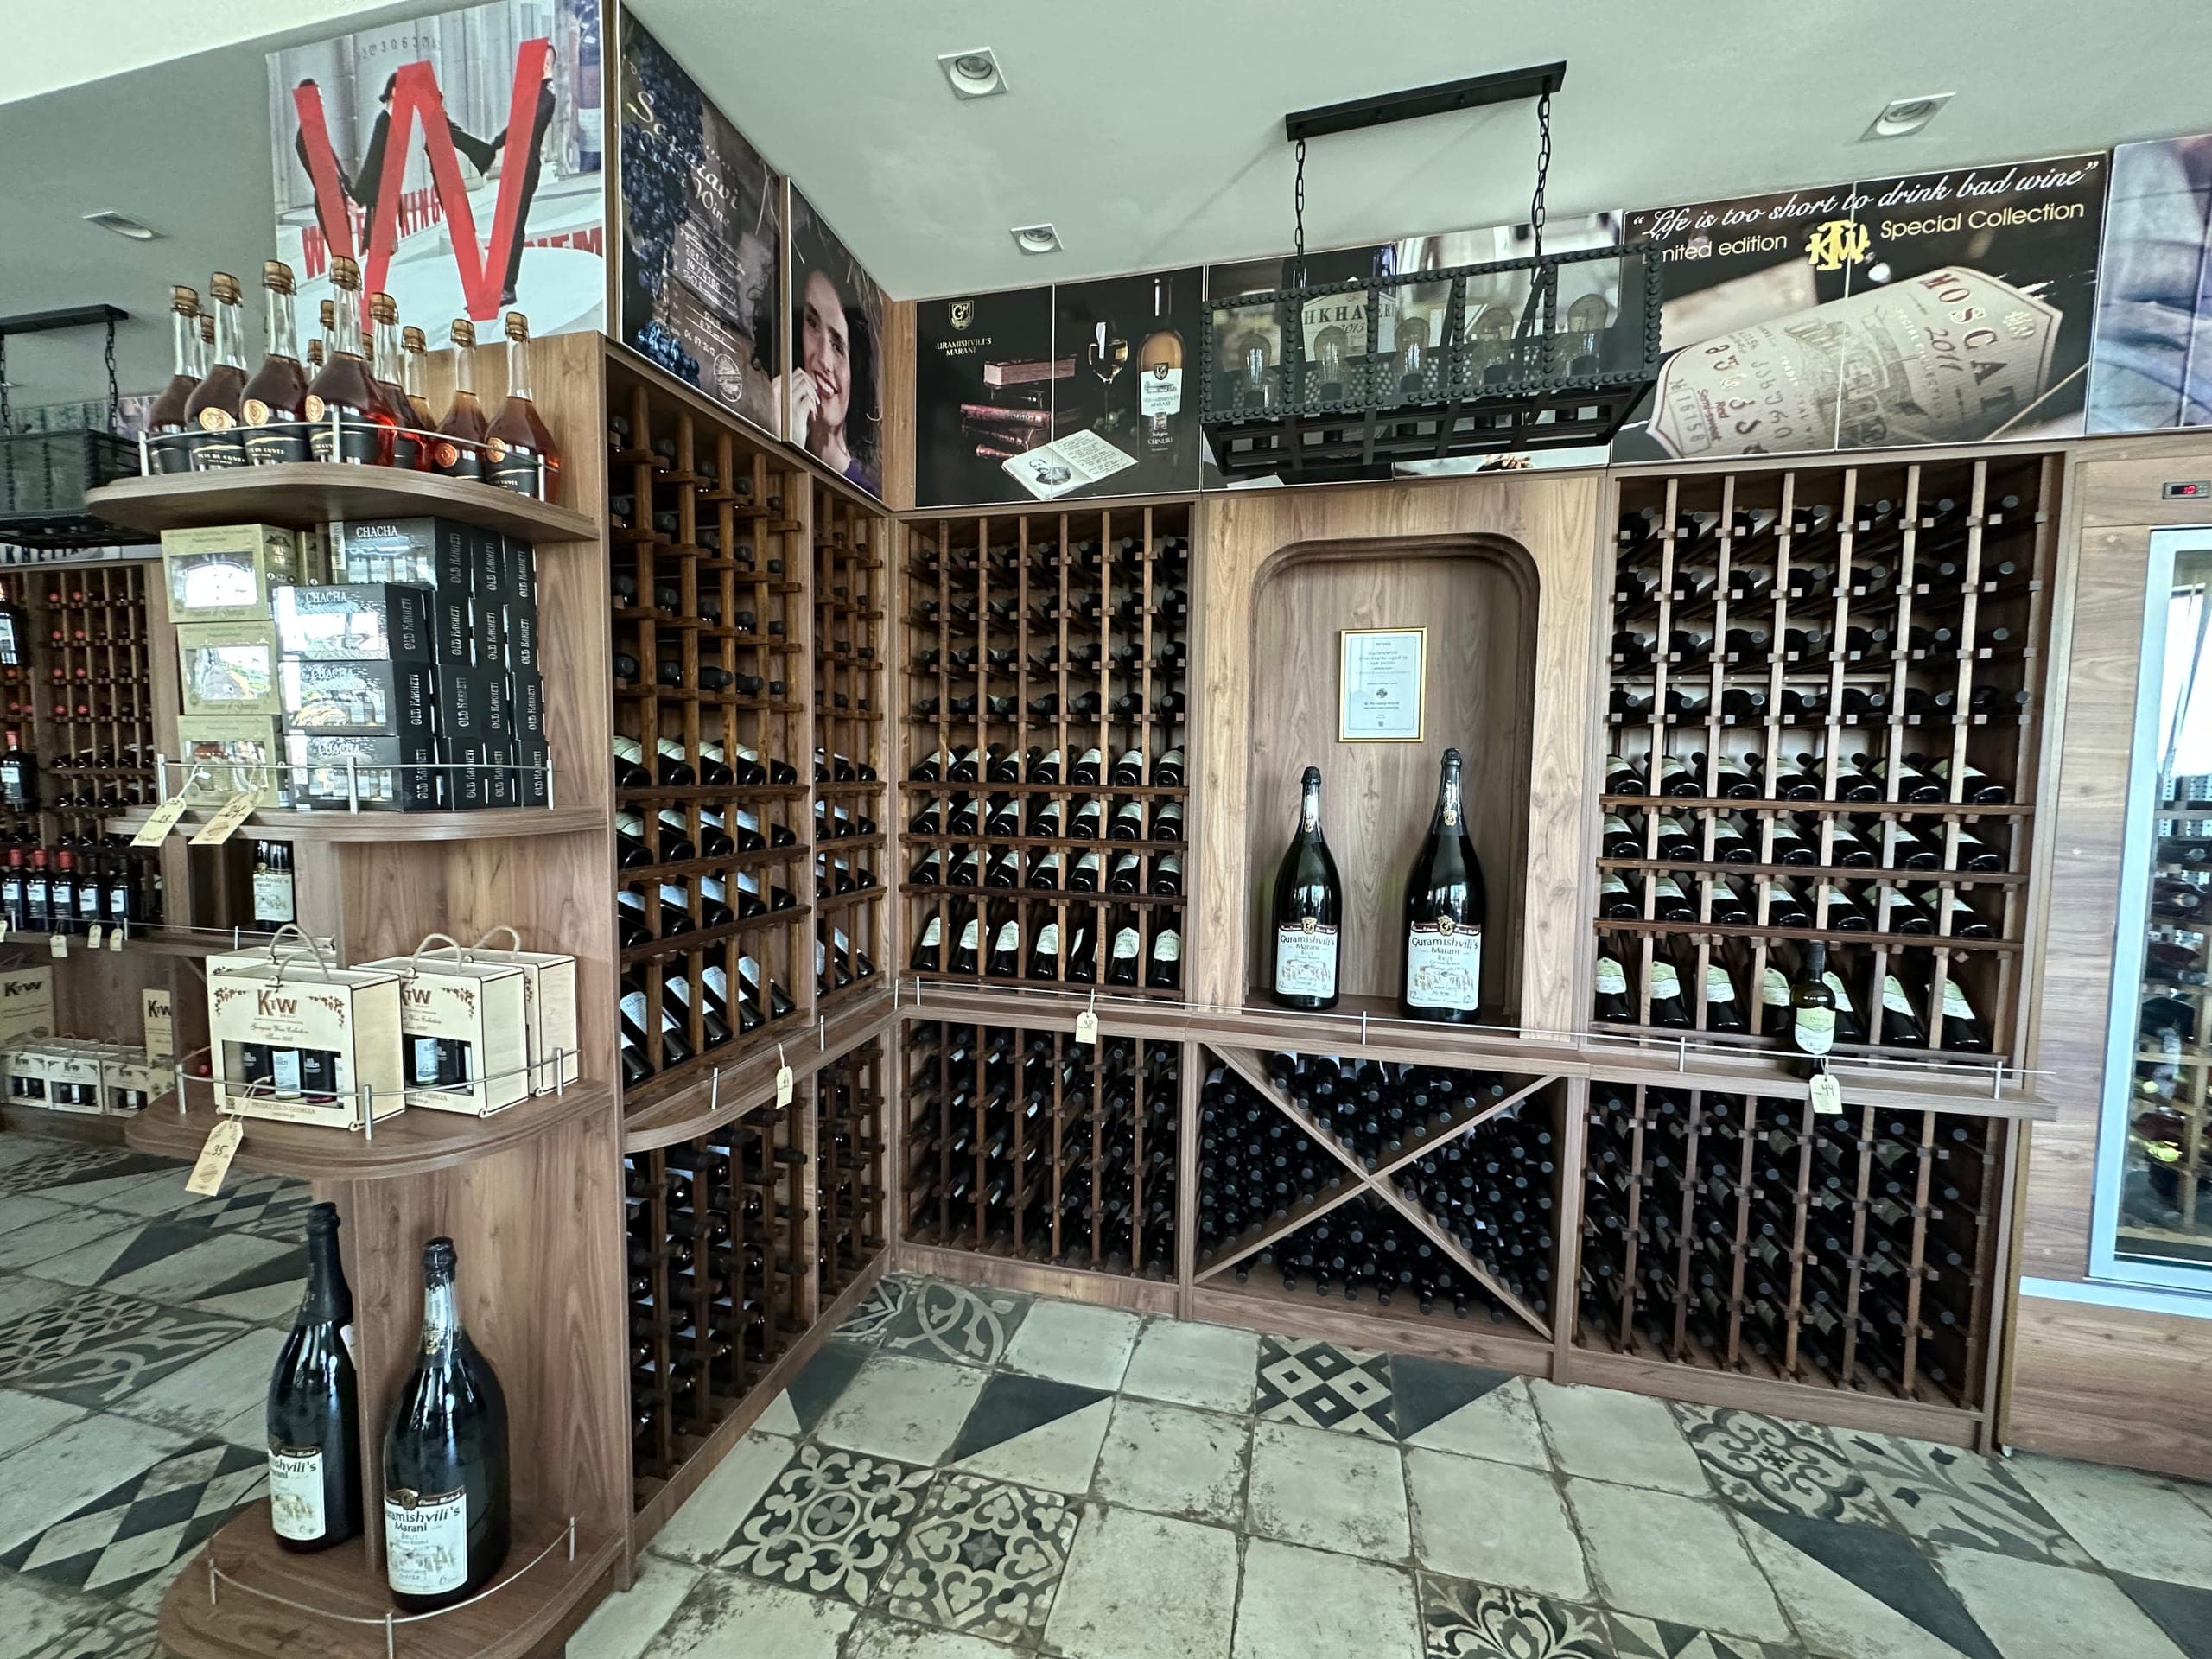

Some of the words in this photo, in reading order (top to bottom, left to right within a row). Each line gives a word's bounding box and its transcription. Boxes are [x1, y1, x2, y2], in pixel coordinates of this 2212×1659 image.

[1694, 210, 1717, 230] is
[1720, 211, 1766, 226] too
[1768, 193, 1840, 220] short
[1840, 193, 1876, 211] to
[1877, 175, 1953, 208] drink
[1955, 167, 2018, 199] bad
[1880, 213, 1962, 241] Special
[1967, 201, 2086, 230] Collection
[1718, 233, 1788, 257] edition
[1923, 326, 1964, 372] 2011
[1715, 400, 1731, 420] Red
[355, 525, 398, 538] CHACHA
[450, 564, 461, 584] OLD
[486, 573, 498, 591] OLD
[306, 590, 347, 603] CHACHA
[518, 580, 529, 598] OLD
[404, 632, 416, 650] OLD
[451, 638, 462, 656] OLD
[487, 643, 499, 660] OLD
[520, 647, 531, 664] OLD
[310, 667, 355, 680] CHACHA
[410, 707, 423, 726] OLD
[457, 709, 470, 728] OLD
[491, 712, 500, 729] OLD
[527, 714, 537, 731] OLD
[316, 742, 362, 756] CHACHA
[417, 781, 429, 800] OLD
[466, 780, 477, 798] OLD
[494, 779, 505, 798] OLD
[534, 780, 543, 797] OLD
[1411, 937, 1479, 950] Guramishvili's
[394, 1522, 428, 1533] Marani
